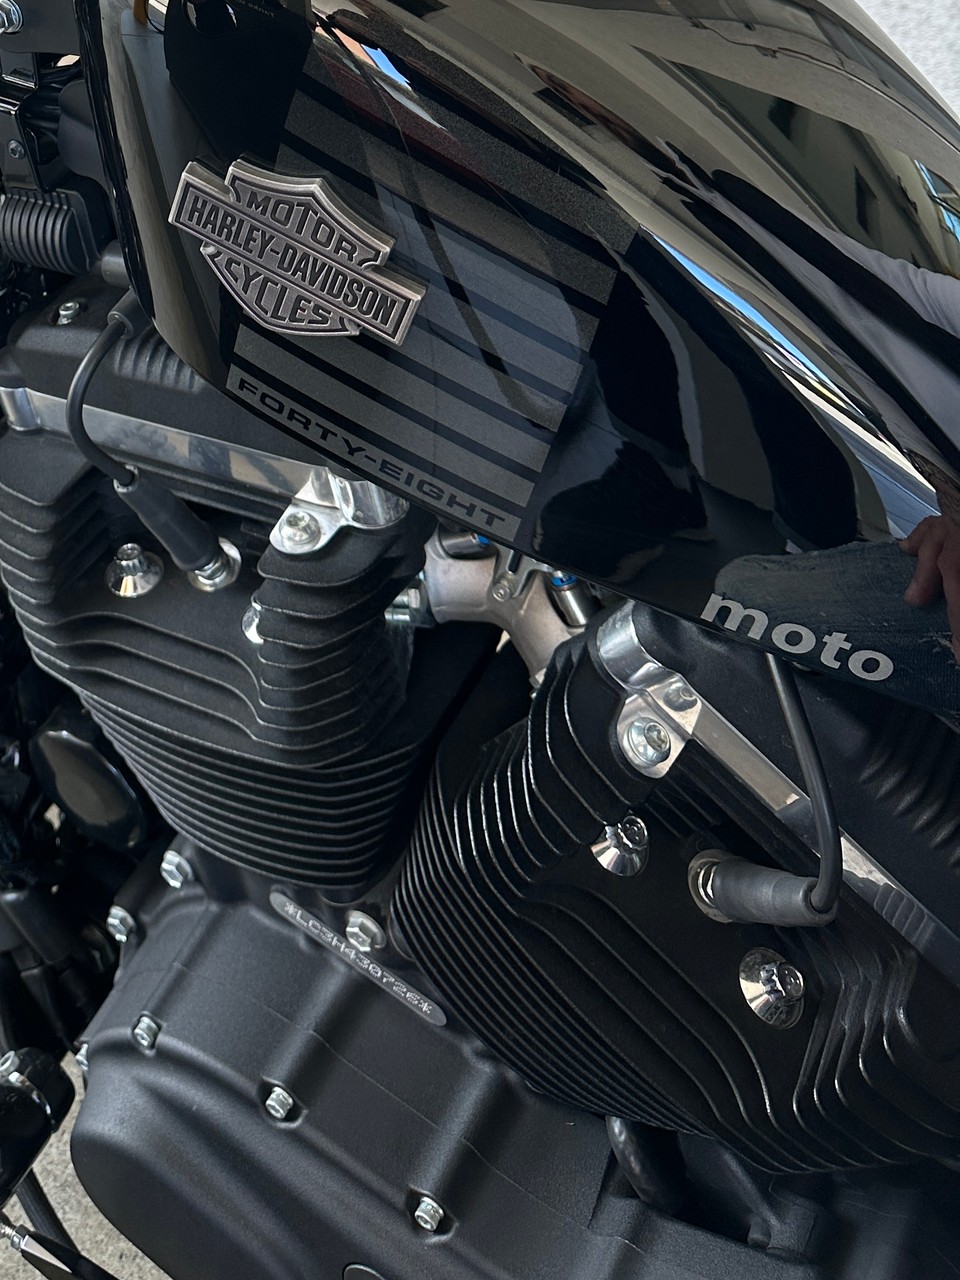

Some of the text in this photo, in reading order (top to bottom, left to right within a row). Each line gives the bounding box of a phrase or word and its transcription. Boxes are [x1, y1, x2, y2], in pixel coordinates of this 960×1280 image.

[187, 195, 399, 327] HARLEY-DAVIDSON
[246, 191, 360, 265] MOTOR
[224, 256, 333, 327] CYCLES
[238, 376, 508, 527] FORTY-EIGHT
[700, 592, 894, 681] moto
